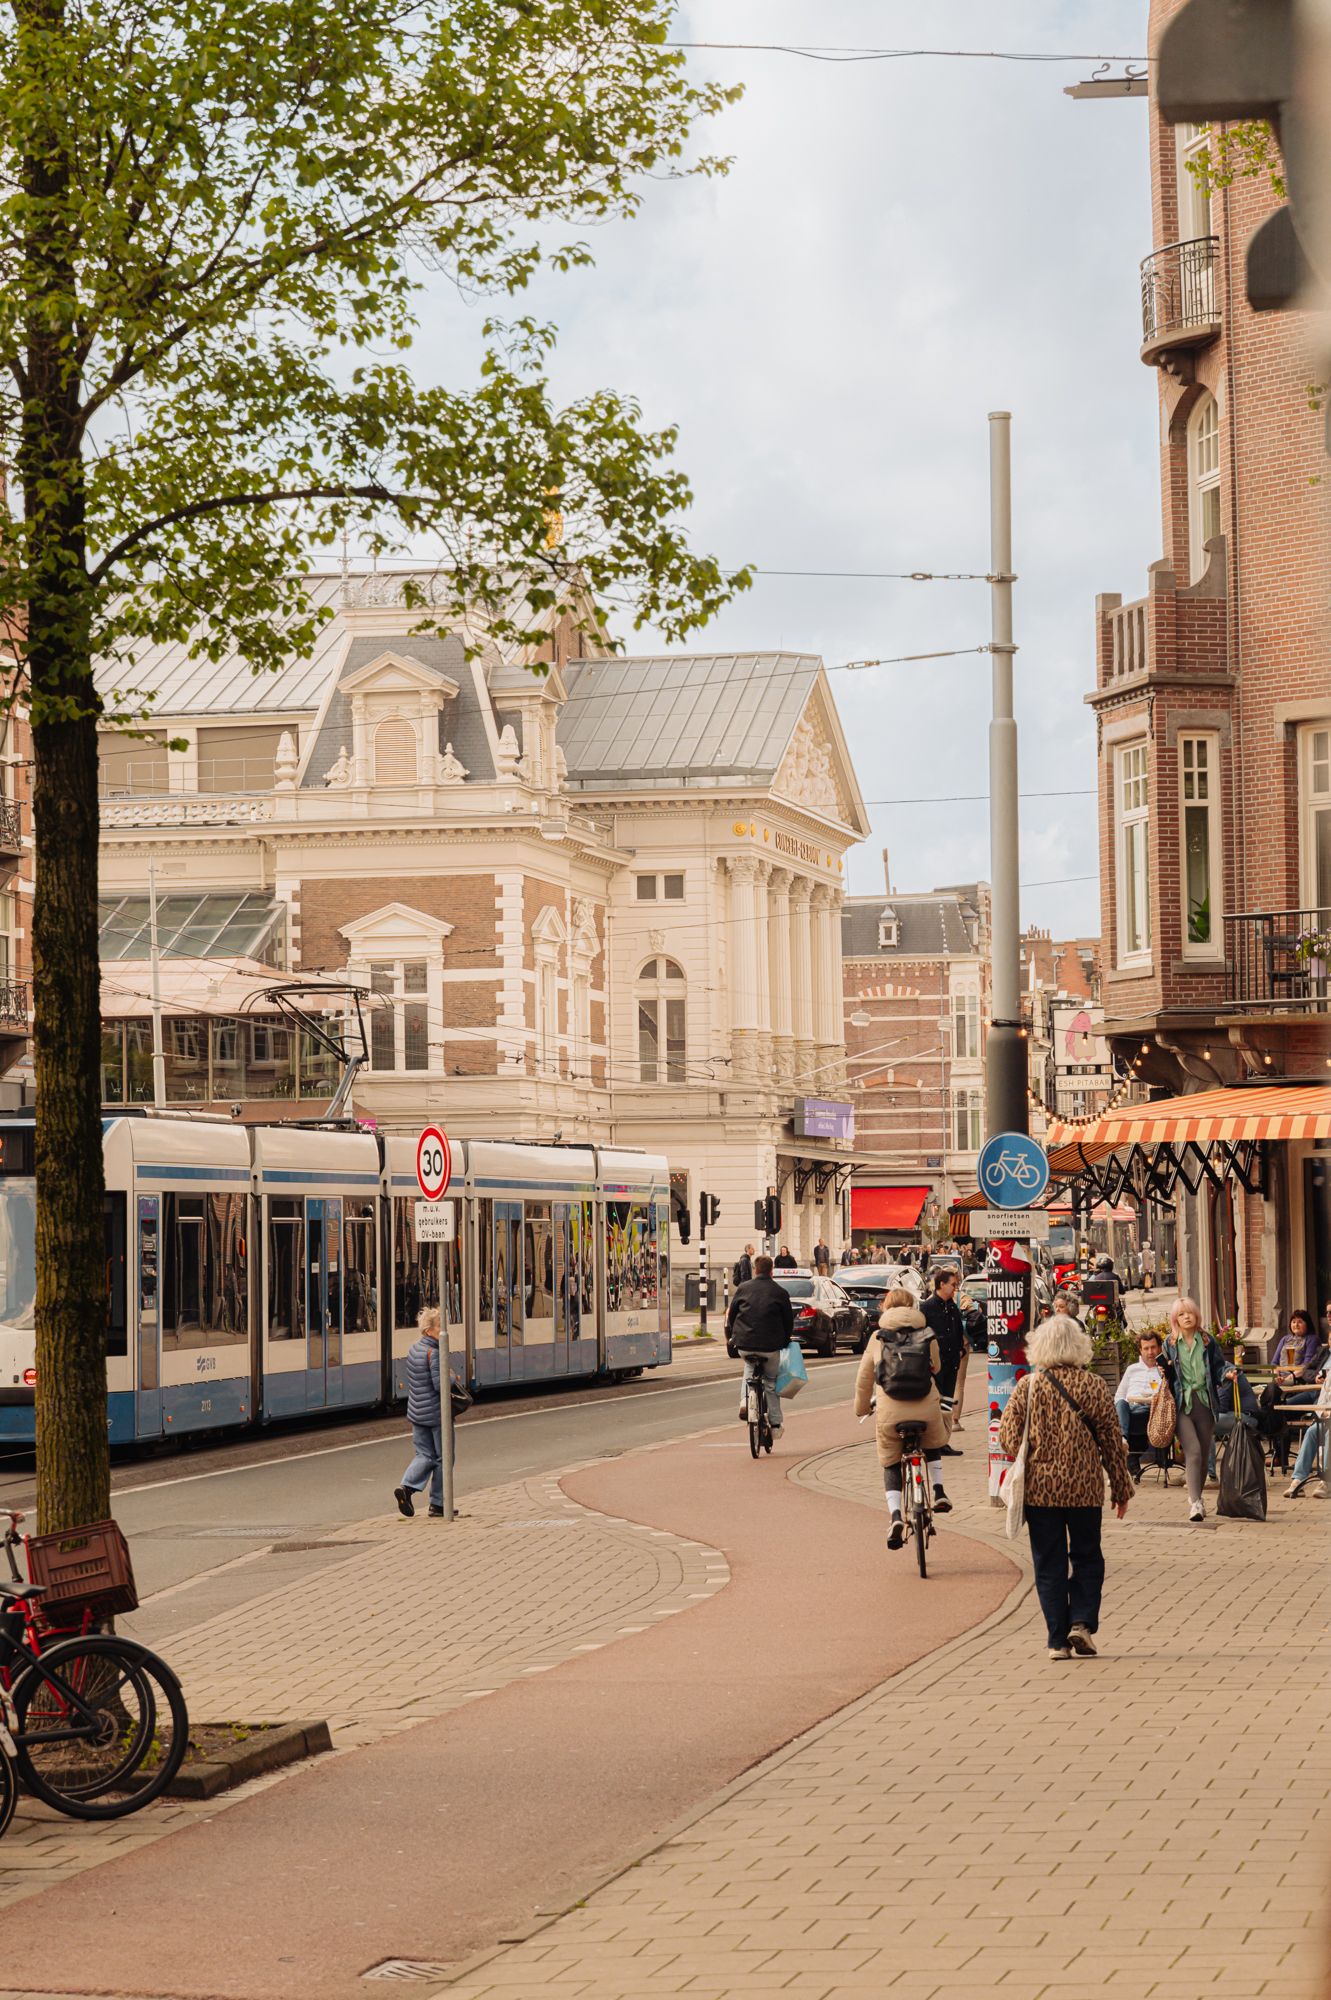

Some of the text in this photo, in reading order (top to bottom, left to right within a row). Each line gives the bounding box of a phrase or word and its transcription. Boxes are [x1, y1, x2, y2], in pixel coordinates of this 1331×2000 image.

[1058, 1078, 1110, 1088] ESH PITABAR
[422, 1149, 443, 1177] 30
[418, 1217, 448, 1228] gebruikers
[421, 1230, 446, 1239] OV-baan
[1006, 1300, 1022, 1316] UP
